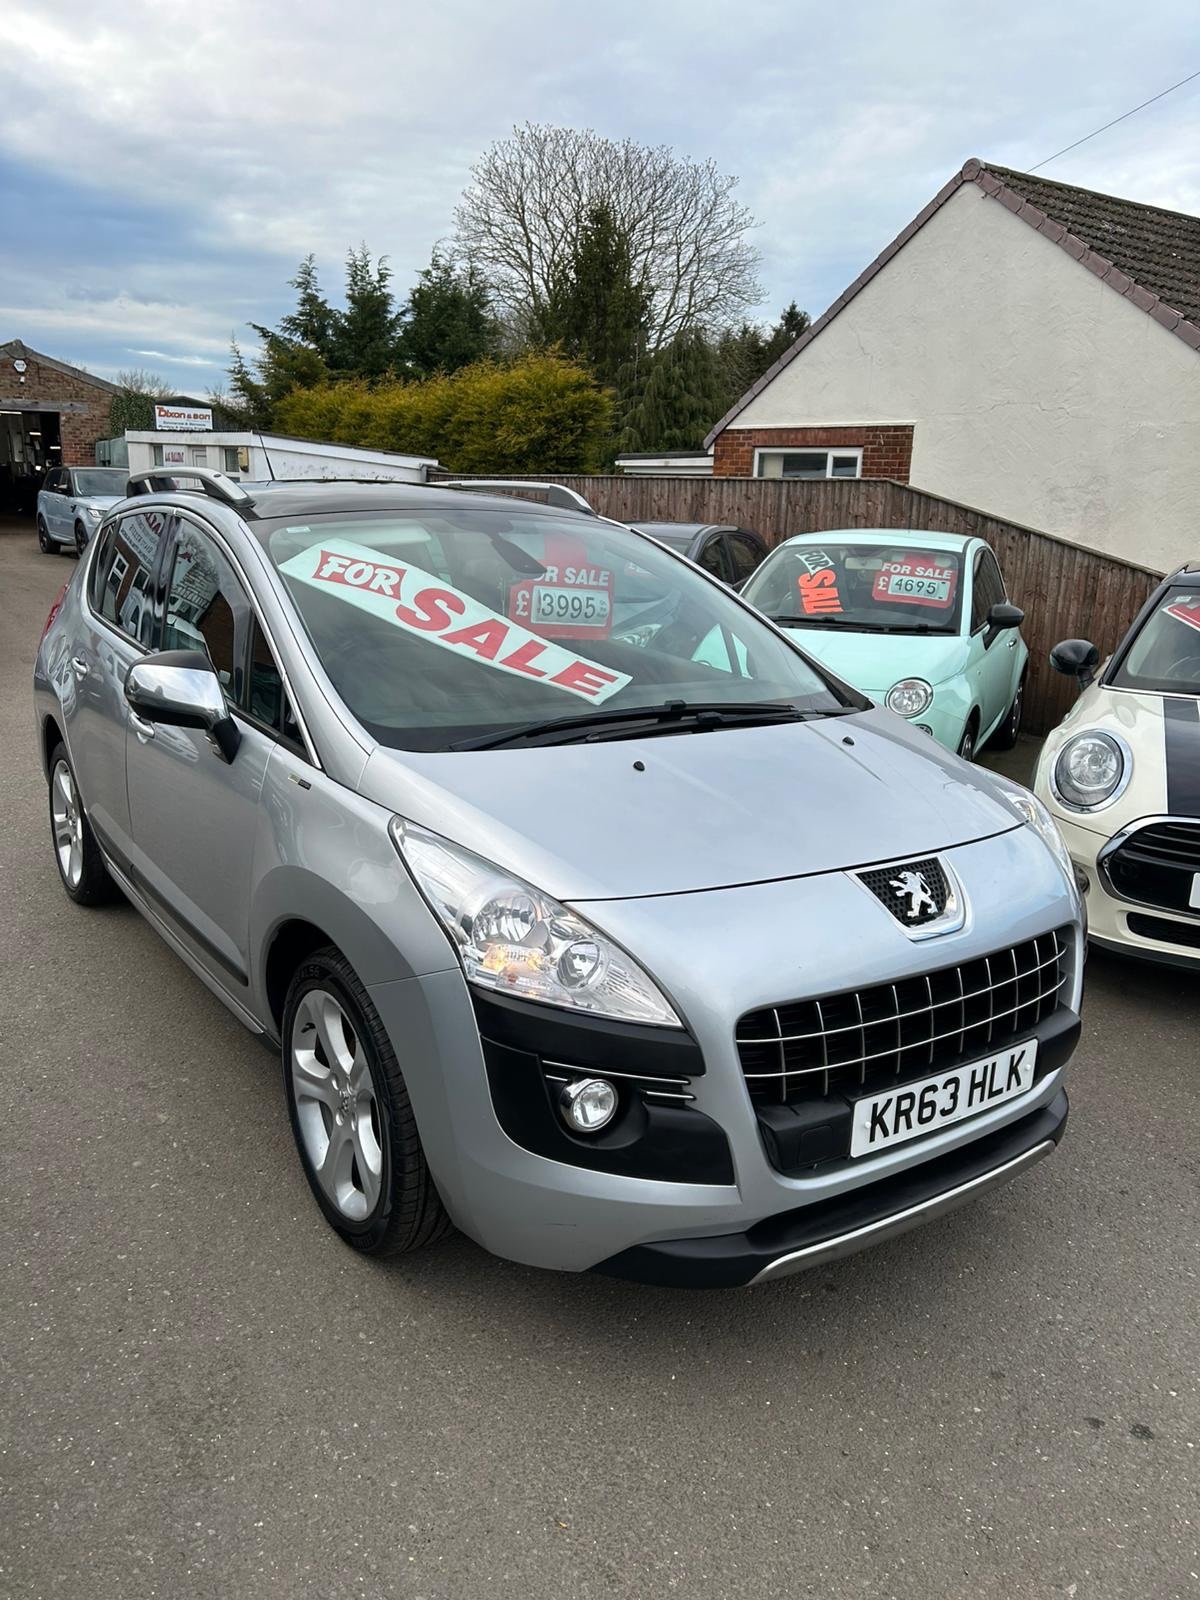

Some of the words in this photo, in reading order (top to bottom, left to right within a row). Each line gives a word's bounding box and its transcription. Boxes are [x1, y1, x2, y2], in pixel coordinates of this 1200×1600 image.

[564, 567, 610, 586] SALE
[882, 563, 912, 575] FOR
[915, 566, 953, 579] SALE
[895, 578, 937, 595] 4695
[541, 593, 596, 620] 3995
[319, 556, 401, 597] FOR
[396, 588, 619, 697] SALE
[869, 1077, 961, 1143] KR63
[967, 1050, 1027, 1108] HLK
